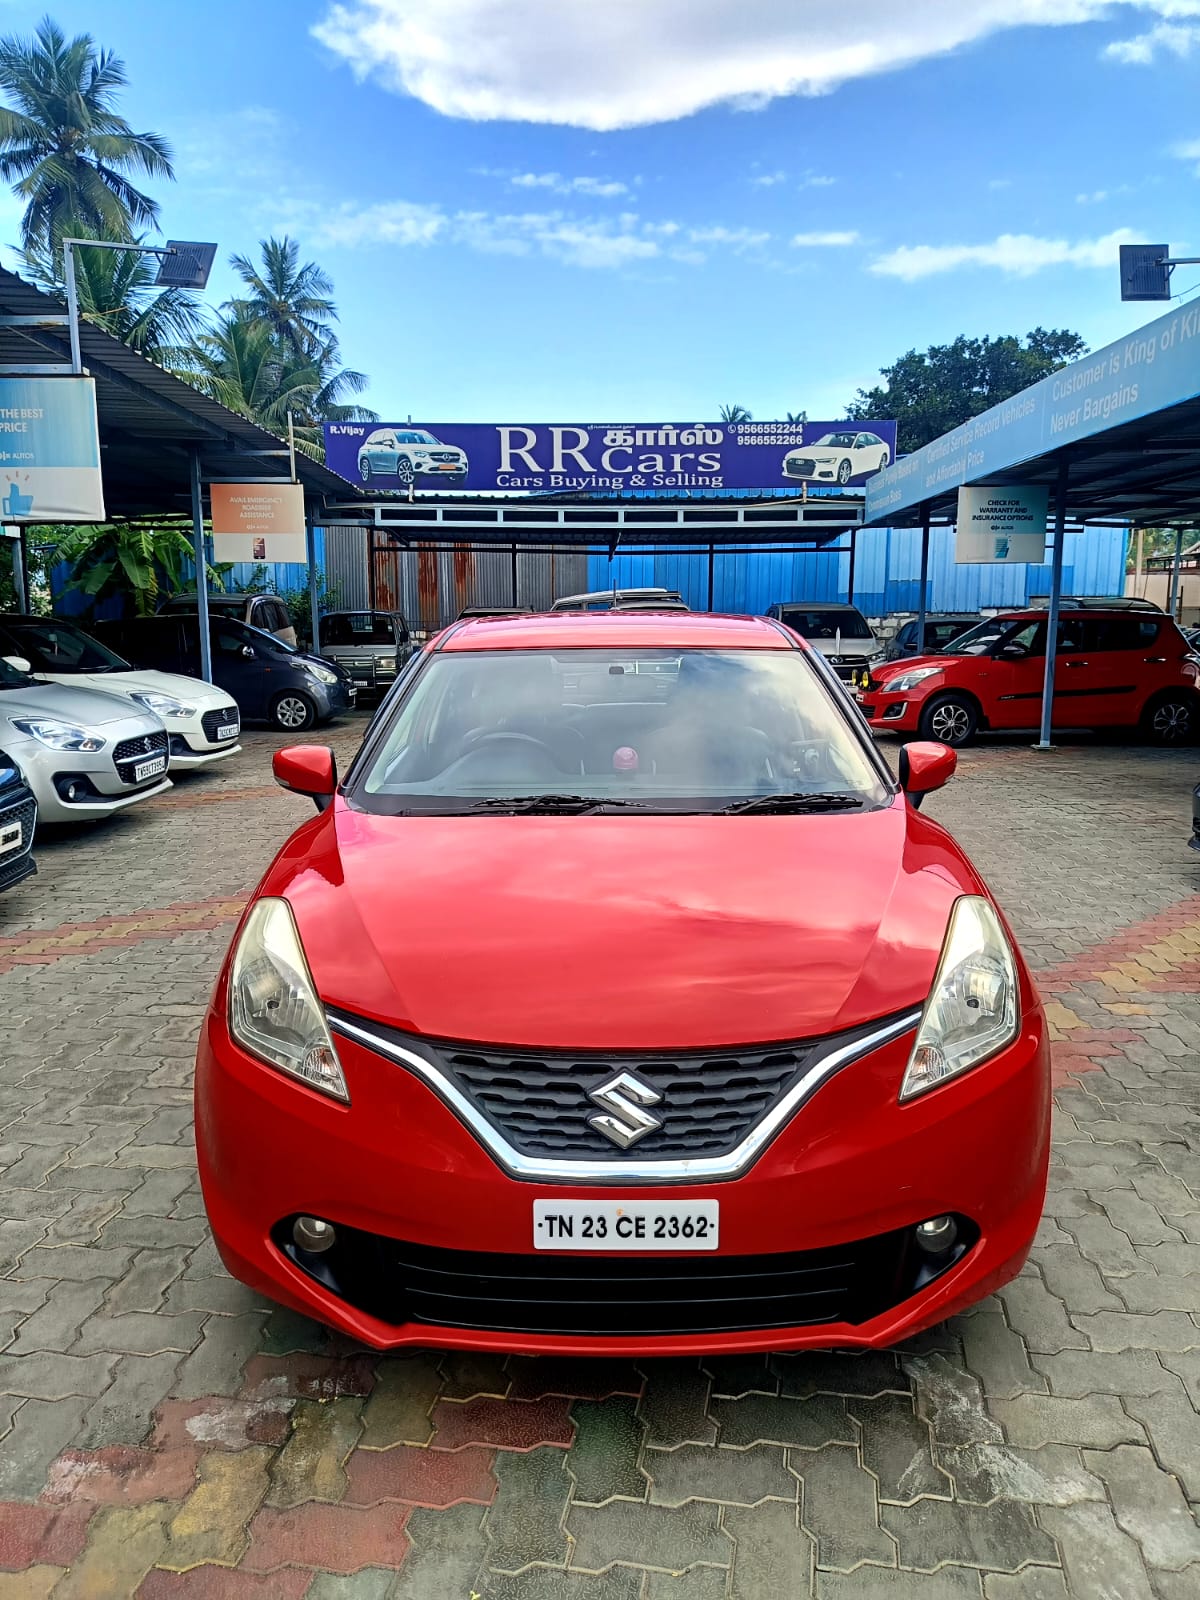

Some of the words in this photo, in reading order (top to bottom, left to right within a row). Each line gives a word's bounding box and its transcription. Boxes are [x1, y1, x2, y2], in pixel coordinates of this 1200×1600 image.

[1053, 360, 1106, 401] Customer
[1109, 352, 1120, 376] is
[1124, 336, 1156, 368] King
[1160, 320, 1178, 350] of
[1180, 307, 1200, 342] Ki
[0, 408, 19, 419] THE
[20, 408, 44, 419] BEST
[1050, 407, 1082, 435] Never
[1083, 383, 1138, 419] Bargains
[0, 422, 28, 433] PRICE
[974, 417, 1000, 440] Record
[1002, 398, 1036, 426] Vehicles
[330, 425, 365, 436] R.Vijay
[602, 423, 724, 447] கார்ஸ்
[737, 424, 803, 434] 9566552244
[495, 426, 598, 472] RR
[601, 446, 721, 473] Cars
[737, 435, 803, 445] 9566552266
[967, 450, 985, 469] Price
[496, 474, 543, 487] Cars
[550, 474, 624, 489] Buying
[629, 474, 646, 486] &
[652, 473, 724, 487] Selling
[544, 1215, 573, 1238] TN
[581, 1215, 608, 1238] 23
[615, 1216, 646, 1239] CE
[653, 1216, 708, 1239] 2362
